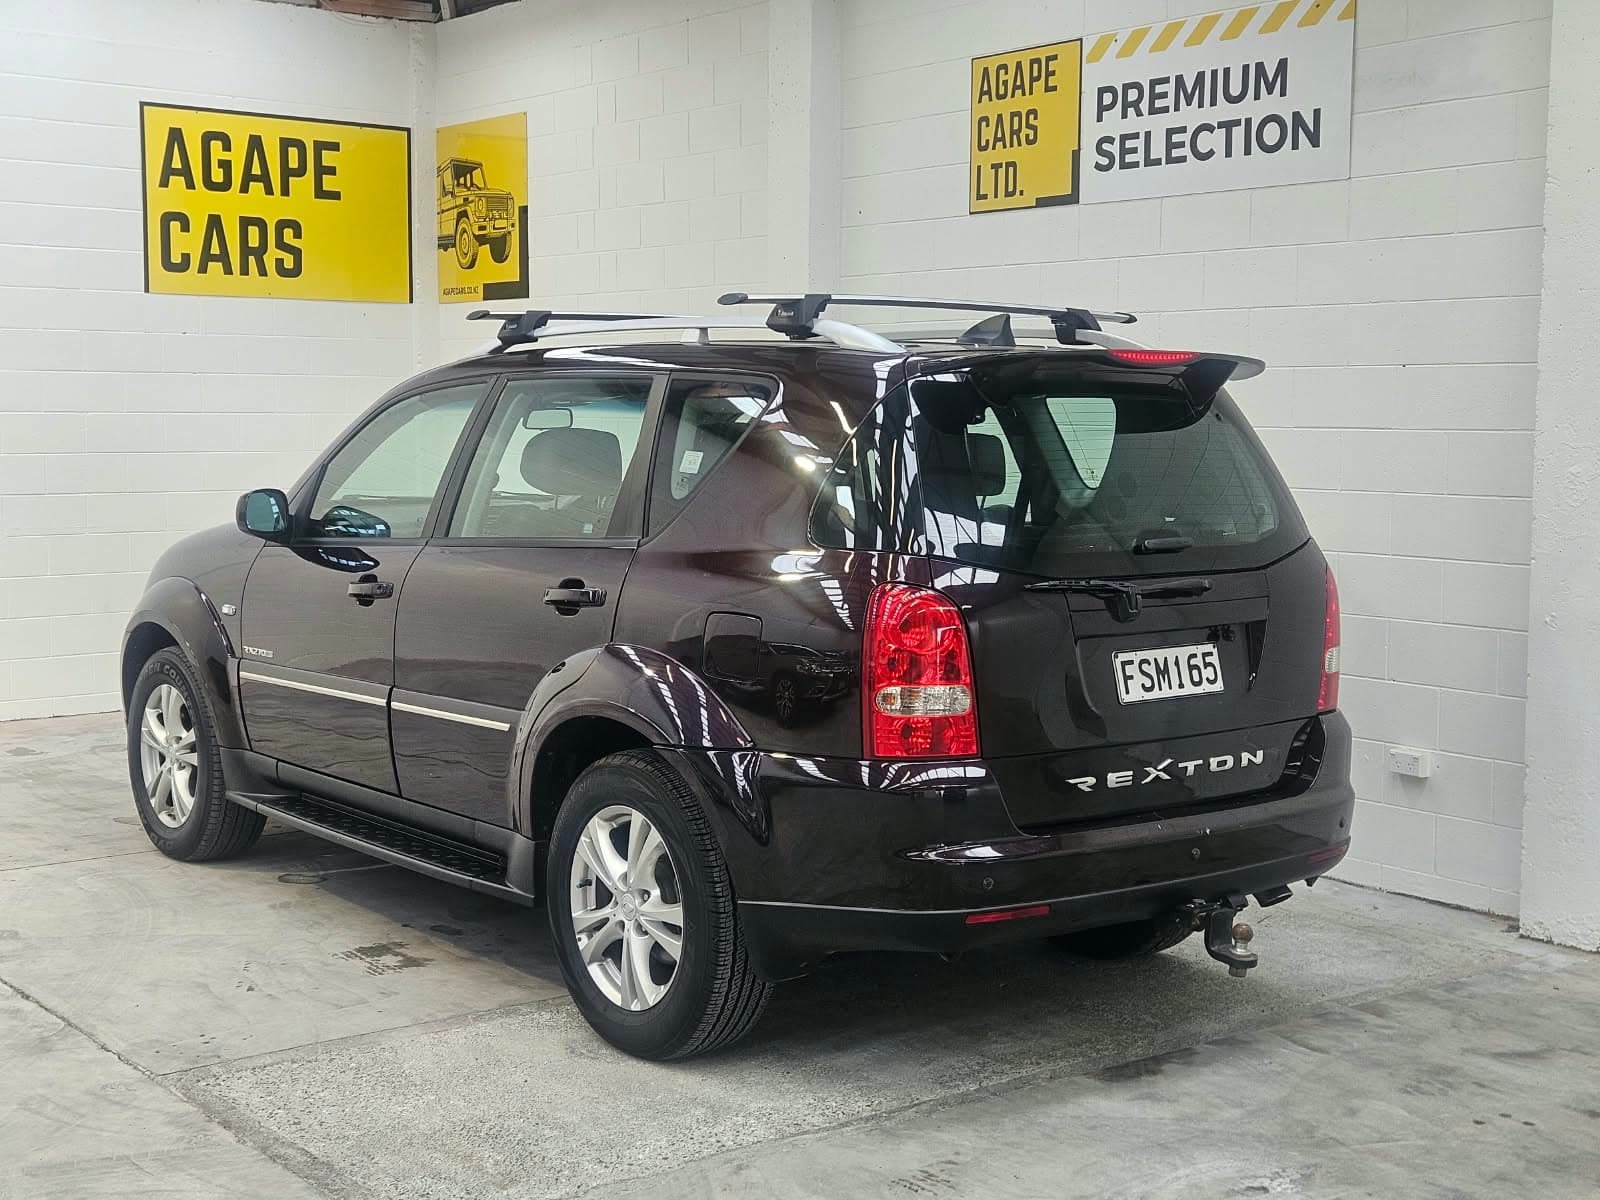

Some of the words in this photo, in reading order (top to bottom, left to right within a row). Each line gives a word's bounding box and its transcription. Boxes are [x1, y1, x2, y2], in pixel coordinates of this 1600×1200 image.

[977, 54, 1059, 104] AGAPE
[1095, 57, 1288, 123] PREMIUM
[976, 108, 1039, 152] CARS
[1093, 107, 1322, 173] SELECTION
[158, 127, 342, 201] AGAPE
[975, 160, 1024, 201] LTD.
[160, 211, 303, 279] CARS
[1120, 651, 1219, 695] FSM165
[1065, 749, 1264, 792] REXTON
